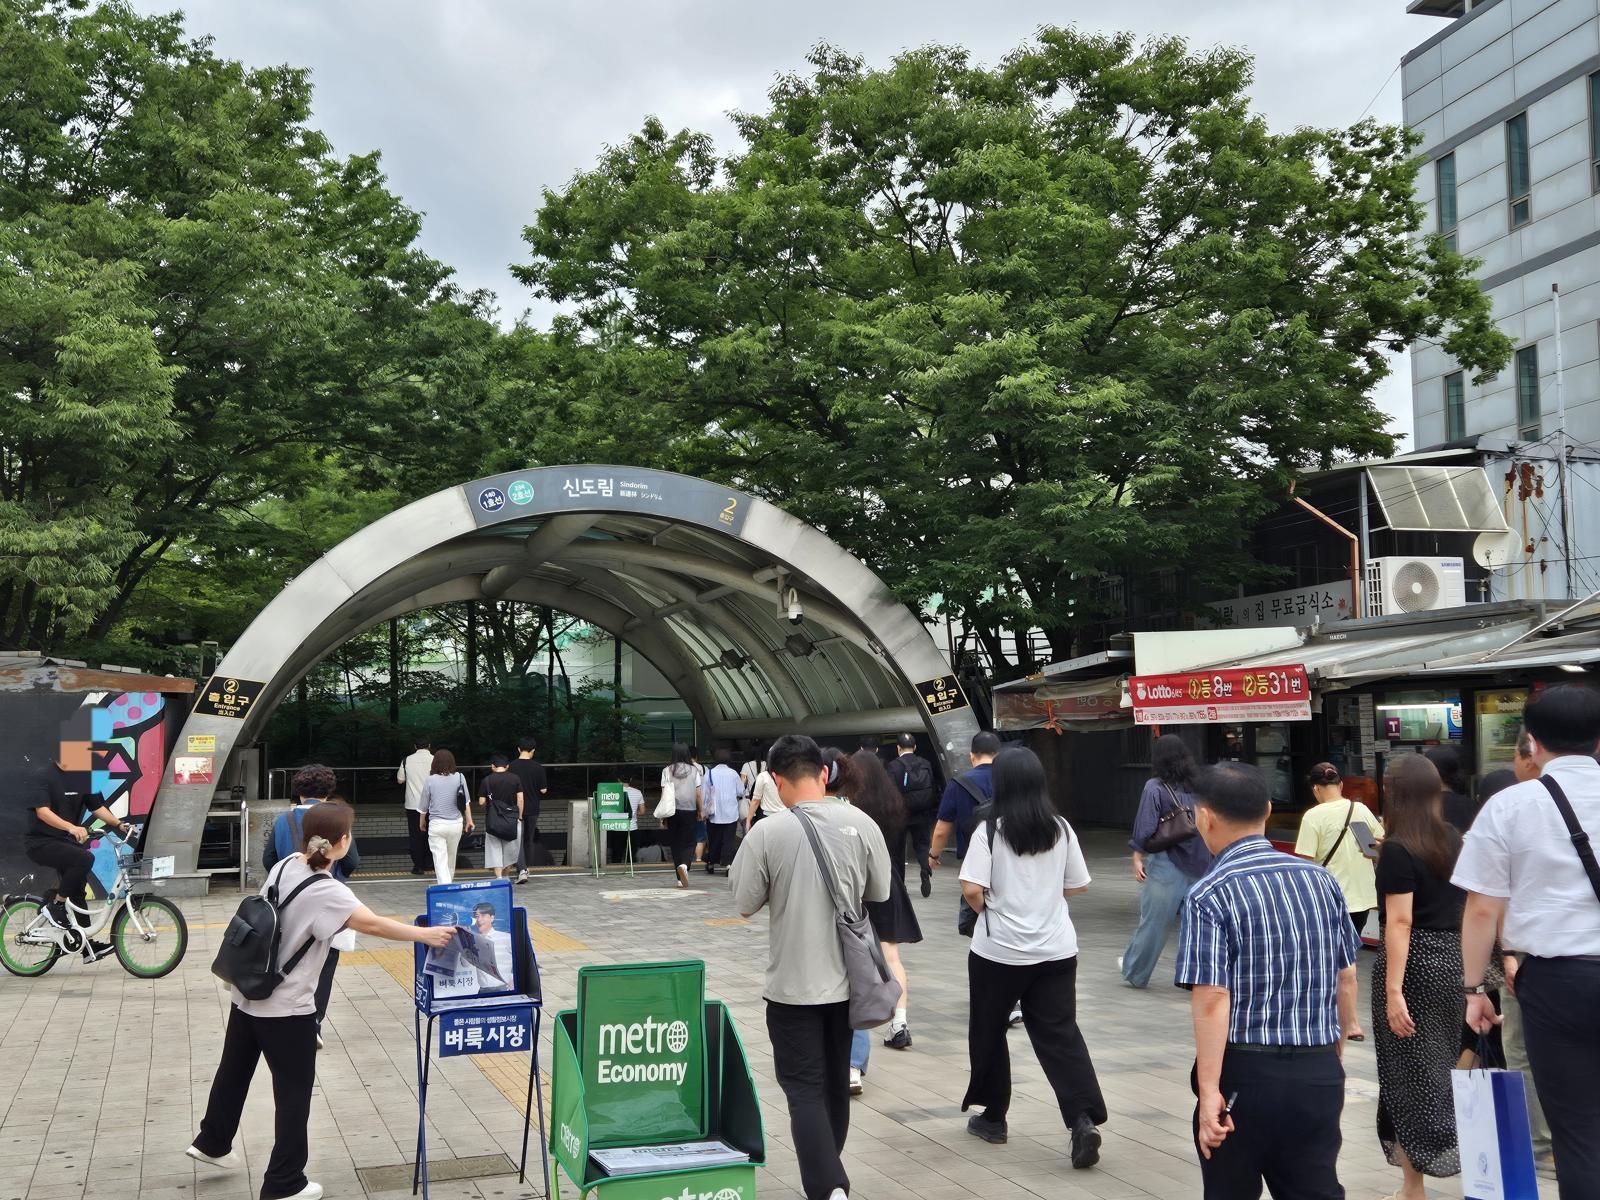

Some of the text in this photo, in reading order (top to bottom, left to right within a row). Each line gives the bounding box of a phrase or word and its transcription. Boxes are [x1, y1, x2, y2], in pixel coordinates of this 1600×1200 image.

[563, 478, 613, 497] 신도림
[620, 481, 648, 490] Sindorim
[483, 495, 503, 508] 1호선
[723, 497, 737, 514] 2
[1255, 600, 1265, 621] 집
[1271, 592, 1334, 619] 무료급식소
[208, 692, 250, 706] 출입구
[926, 689, 958, 704] 출입구
[1147, 685, 1171, 699] Lotto
[214, 703, 240, 712] Entrance
[601, 792, 620, 800] metro
[602, 822, 627, 830] metro
[439, 977, 473, 988] 벼룩시장
[445, 1025, 525, 1051] 벼룩시장
[598, 1016, 689, 1056] metro
[598, 1060, 688, 1086] Economy
[561, 1122, 580, 1159] metro
